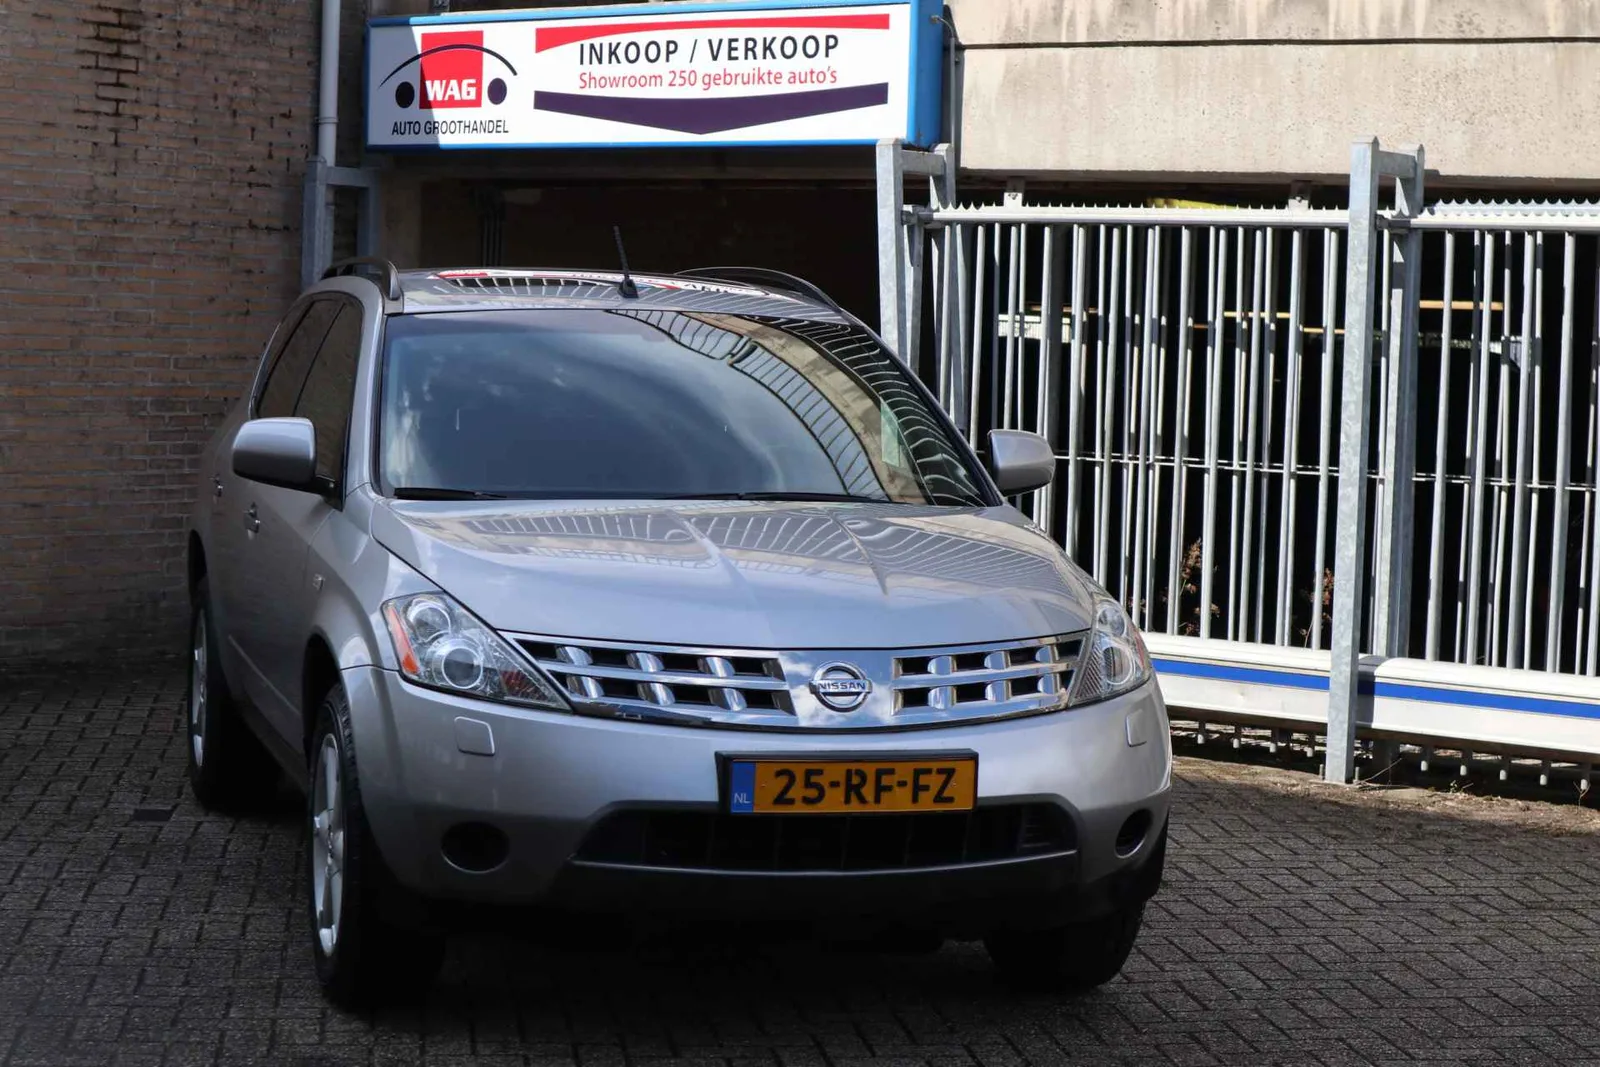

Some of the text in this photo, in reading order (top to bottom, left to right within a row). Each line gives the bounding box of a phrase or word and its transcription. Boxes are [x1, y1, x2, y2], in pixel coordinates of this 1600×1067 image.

[579, 34, 839, 65] INKOOP / VERKOOP
[425, 78, 477, 101] WAG
[579, 65, 838, 91] Showroom 250 gebruikte auto's
[391, 119, 509, 136] AUTO GROOTHANDEL
[817, 681, 866, 691] NISSAN
[733, 792, 751, 804] NL
[771, 767, 956, 806] 25-RF-FZ
